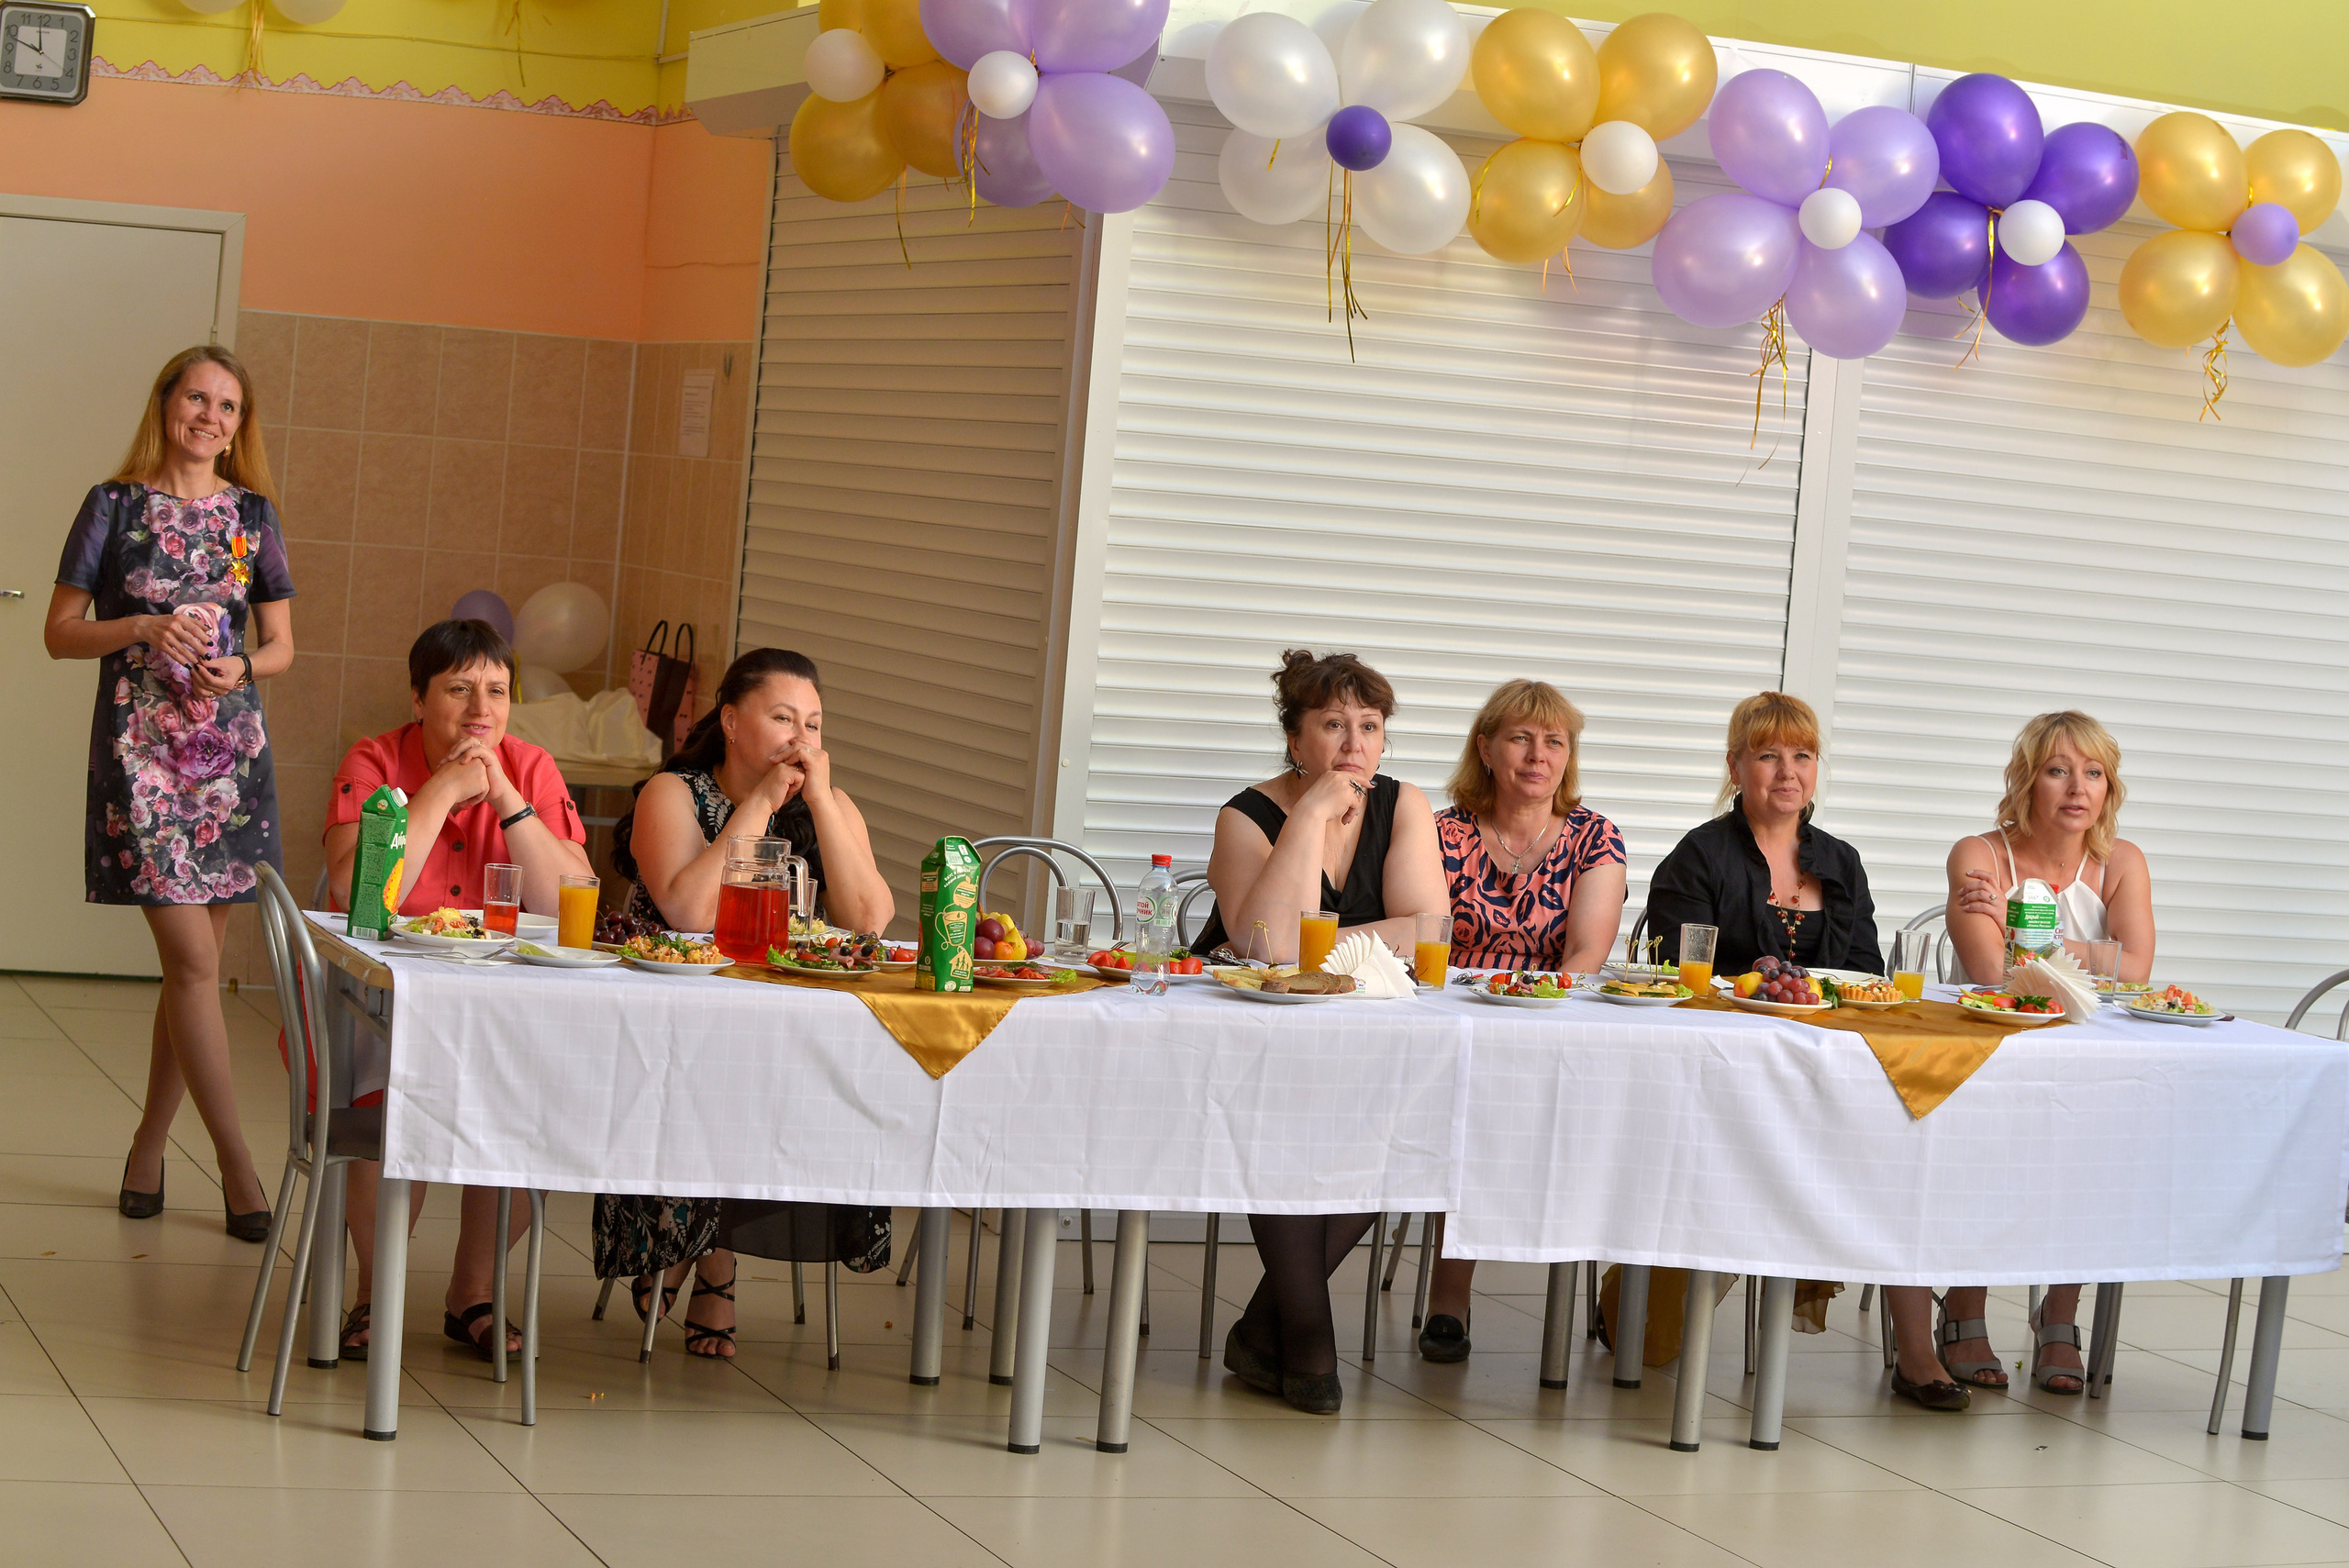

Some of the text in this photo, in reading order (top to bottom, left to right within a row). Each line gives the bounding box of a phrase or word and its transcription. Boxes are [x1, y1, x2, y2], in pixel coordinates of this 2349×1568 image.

[21, 14, 31, 25] 11
[38, 15, 51, 28] 12
[59, 17, 65, 28] 1
[5, 24, 18, 38] 10
[70, 30, 79, 43] 2
[5, 42, 15, 55] 9
[67, 48, 77, 61] 3
[3, 61, 12, 74] 8
[65, 68, 74, 79] 4
[16, 74, 24, 87] 7
[32, 77, 42, 89] 6
[50, 78, 60, 91] 5
